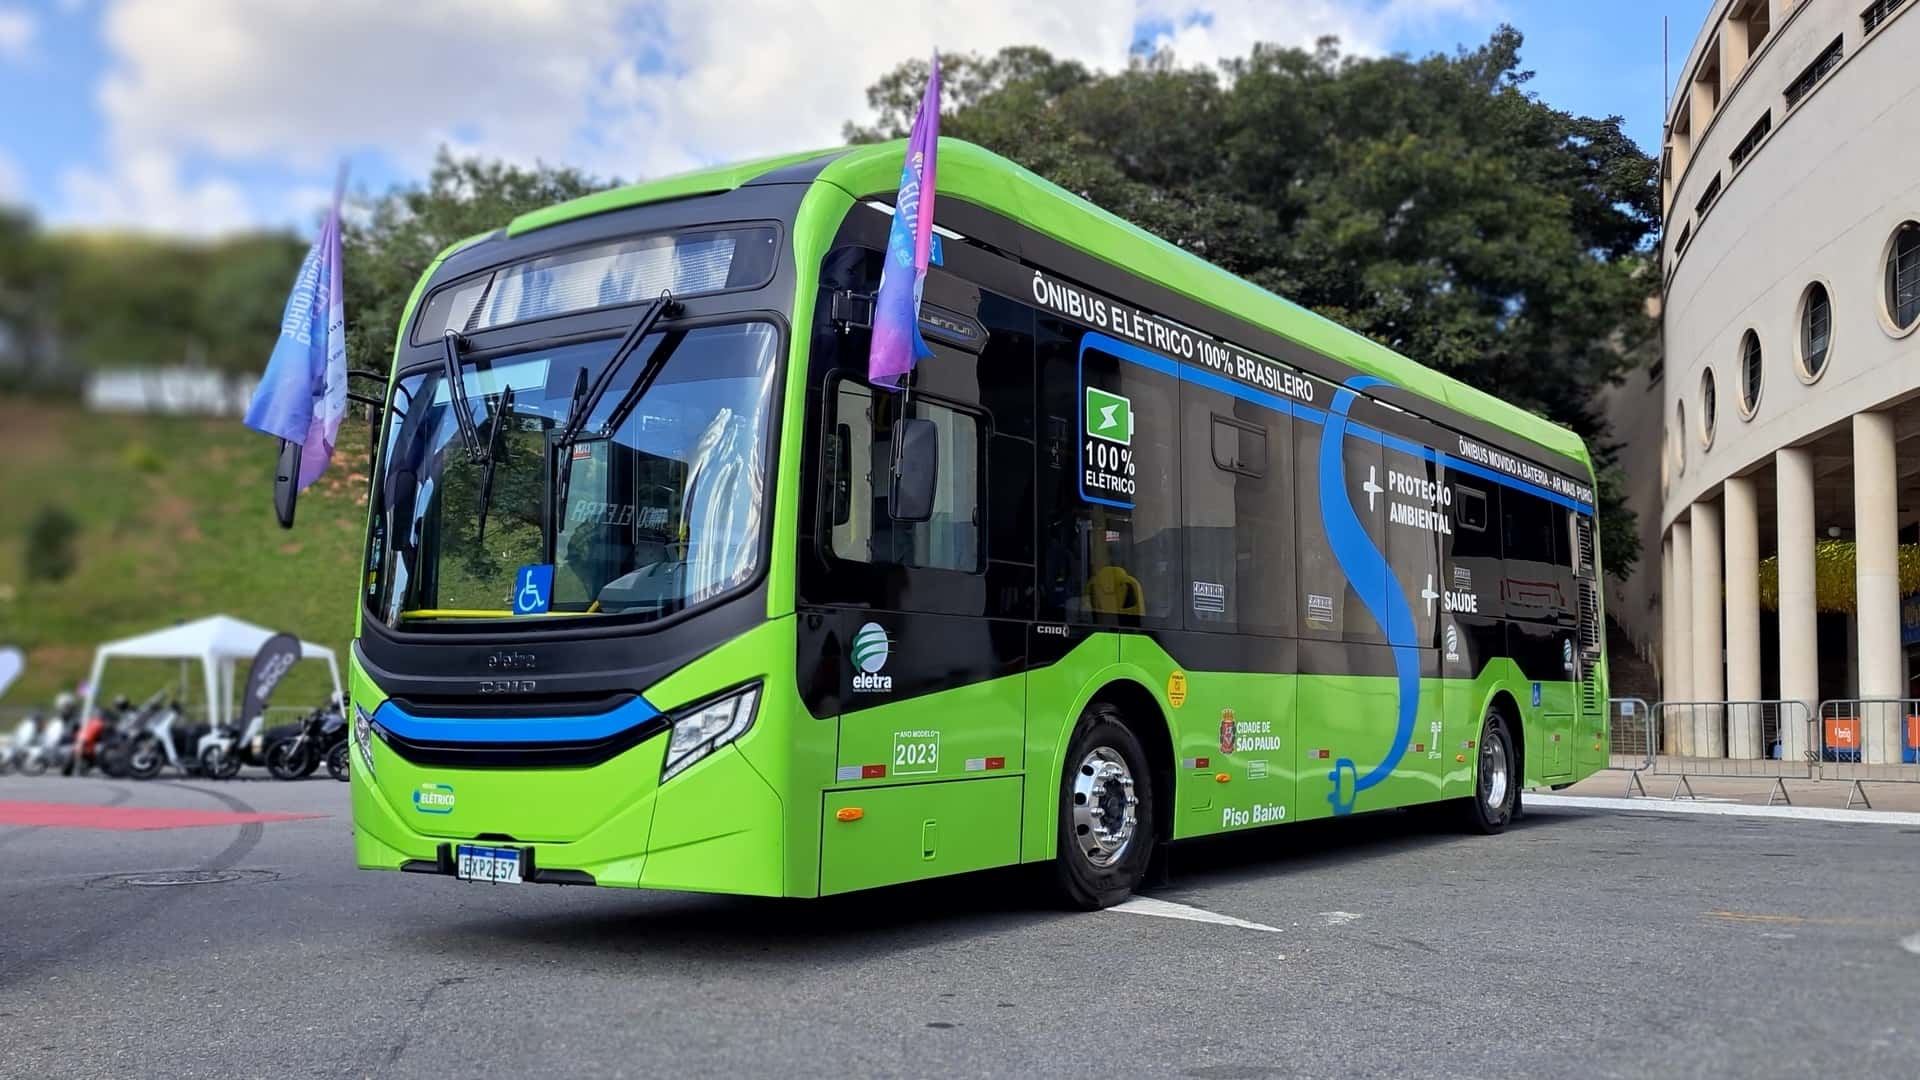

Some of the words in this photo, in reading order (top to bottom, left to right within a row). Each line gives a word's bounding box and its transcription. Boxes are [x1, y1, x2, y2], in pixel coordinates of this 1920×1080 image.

[1032, 271, 1108, 327] ÔNIBUS
[1112, 306, 1193, 359] ELÉTRICO
[1197, 340, 1234, 375] 100%
[1237, 355, 1313, 402] BRASILEIRO
[1085, 440, 1136, 476] 100%
[1459, 435, 1488, 464] ÔNIBUS
[1522, 464, 1549, 487] BATERIA
[1085, 469, 1136, 495] ELÉTRICO
[1389, 470, 1451, 507] PROTEÇÃO
[1390, 502, 1452, 535] AMBIENTAL
[1444, 588, 1478, 613] SAÚDE
[853, 672, 892, 689] eletra
[1237, 721, 1261, 734] CIDADE
[1262, 721, 1271, 733] DE
[896, 743, 937, 765] 2023
[1237, 735, 1254, 752] SÃO
[1255, 736, 1281, 751] PAULO
[421, 791, 455, 806] ELÉTRICO
[1223, 807, 1249, 827] Piso
[1252, 802, 1286, 823] Baixo
